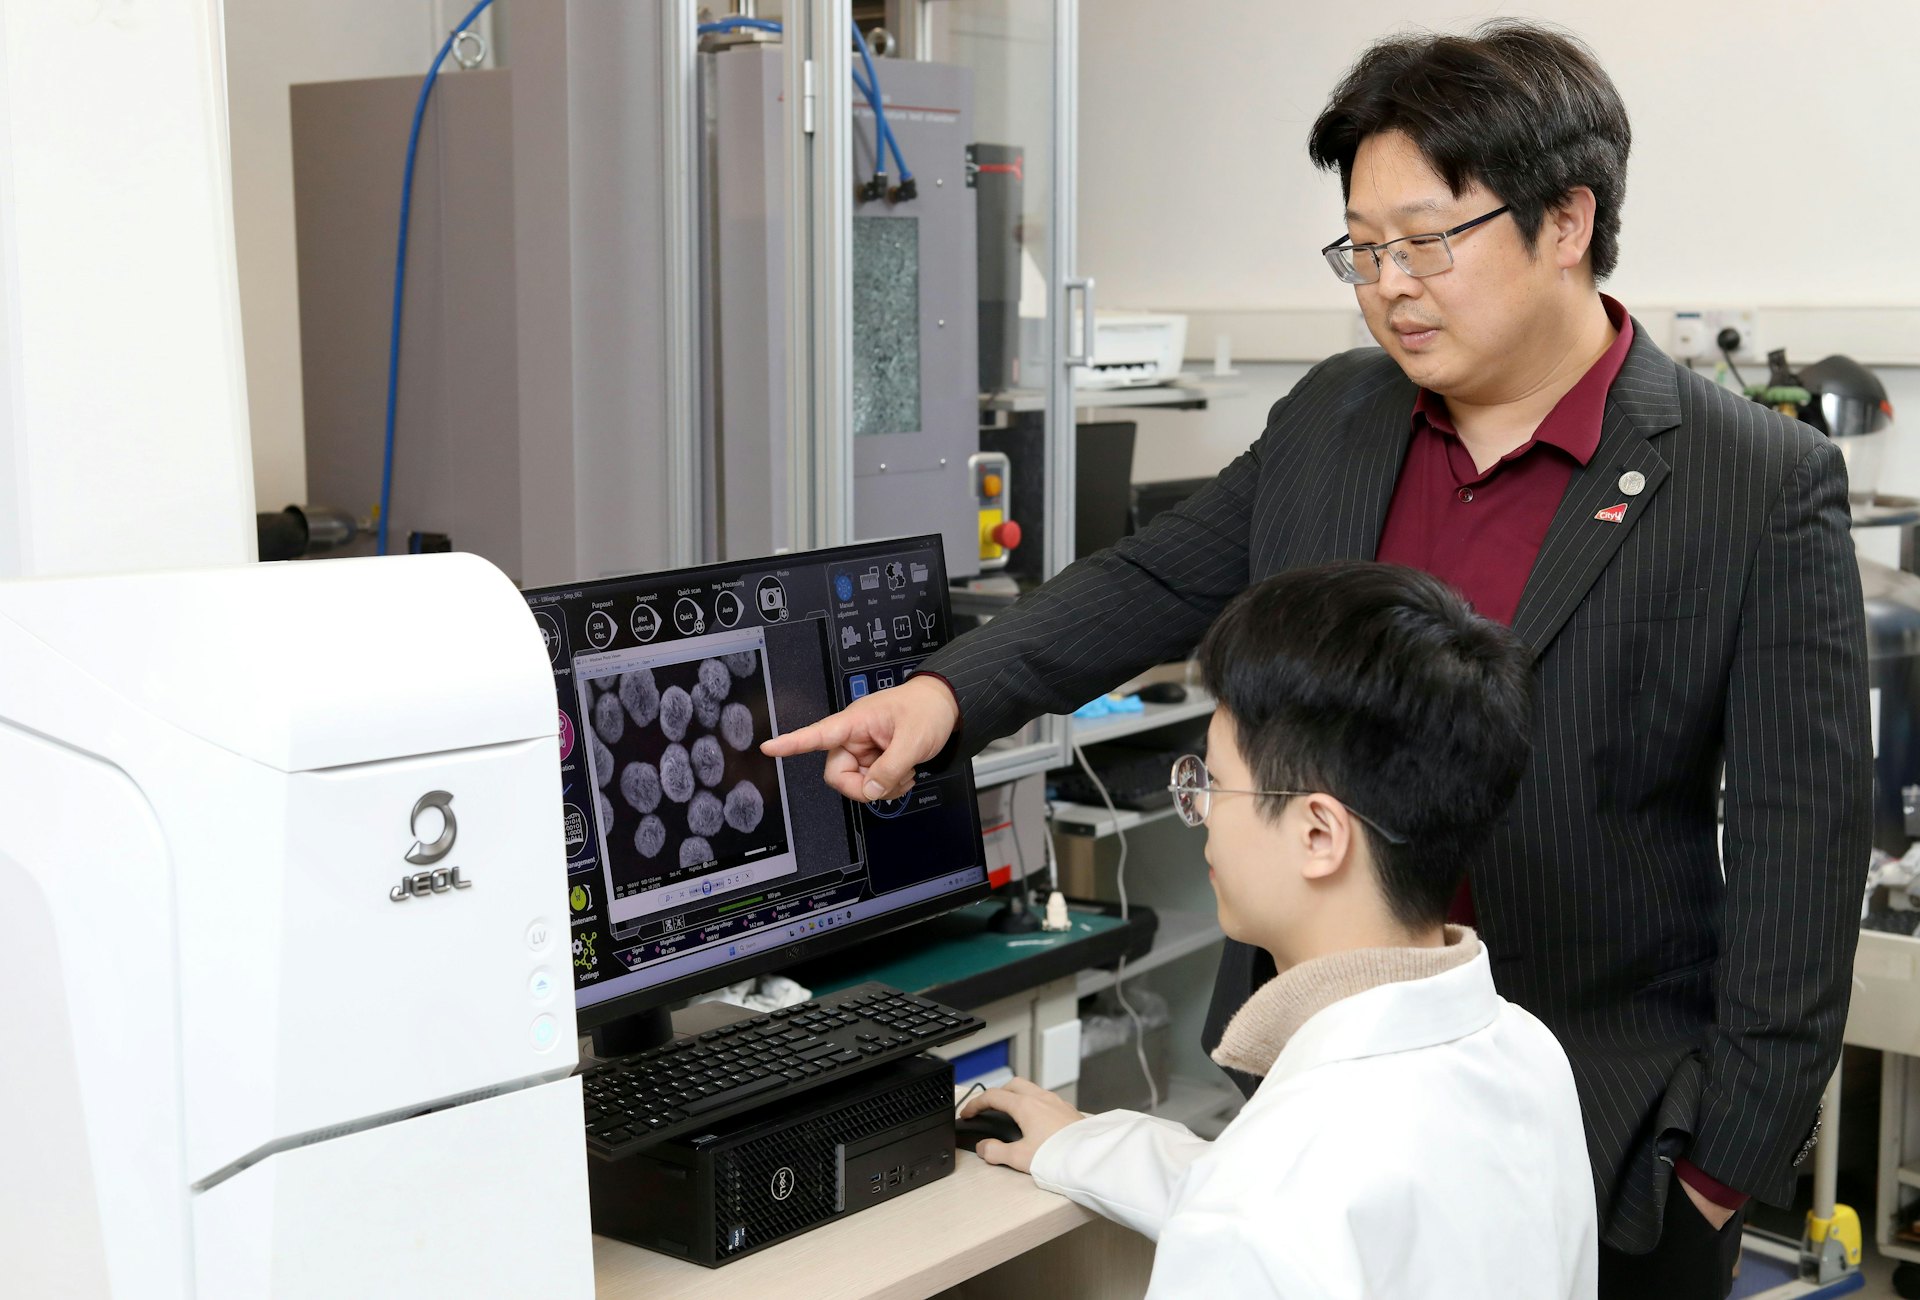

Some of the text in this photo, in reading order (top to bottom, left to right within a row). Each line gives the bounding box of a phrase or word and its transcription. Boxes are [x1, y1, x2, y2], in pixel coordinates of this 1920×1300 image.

[1600, 511, 1621, 520] CityU
[722, 580, 744, 589] Processing
[636, 594, 658, 603] Purpose2
[592, 600, 613, 609] Purpose1
[680, 613, 693, 621] Quick
[838, 610, 858, 618] adjustment
[635, 624, 654, 633] selected)
[595, 632, 606, 640] Obs.
[561, 764, 575, 772] ation
[567, 857, 596, 869] anagement
[390, 867, 472, 902] JEOL
[571, 915, 597, 926] aintenance
[532, 931, 546, 944] LV
[580, 970, 600, 982] Settings
